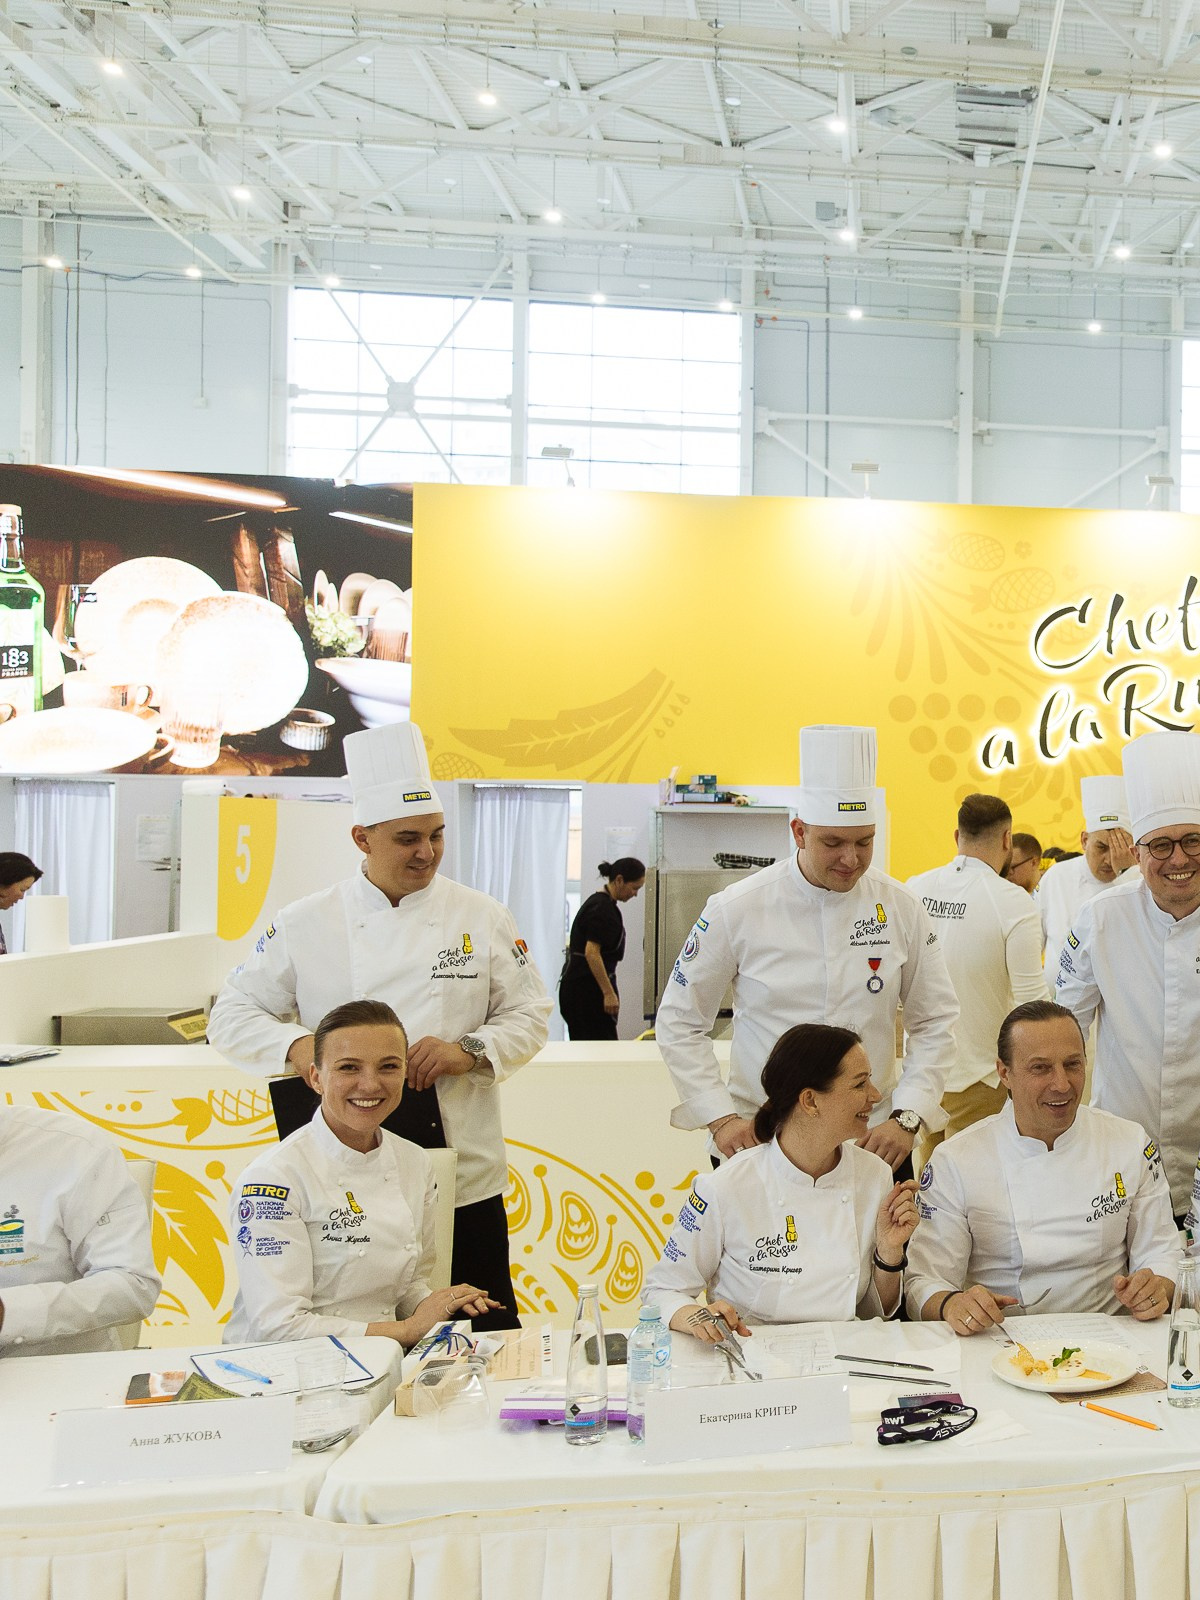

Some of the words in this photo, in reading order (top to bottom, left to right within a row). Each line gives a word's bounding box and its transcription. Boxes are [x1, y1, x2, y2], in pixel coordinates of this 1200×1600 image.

[982, 733, 1015, 769] a
[1039, 689, 1103, 759] la
[404, 792, 431, 802] METRO
[839, 803, 866, 811] METRO
[236, 825, 251, 884] 5
[243, 1185, 288, 1199] METRO
[321, 1233, 342, 1242] Анна
[749, 1264, 780, 1273] Екатерина
[700, 1411, 752, 1424] Екатерина
[755, 1405, 798, 1418] КРИГЕР
[130, 1437, 160, 1447] Анна
[163, 1430, 222, 1445] ЖУКОВА
